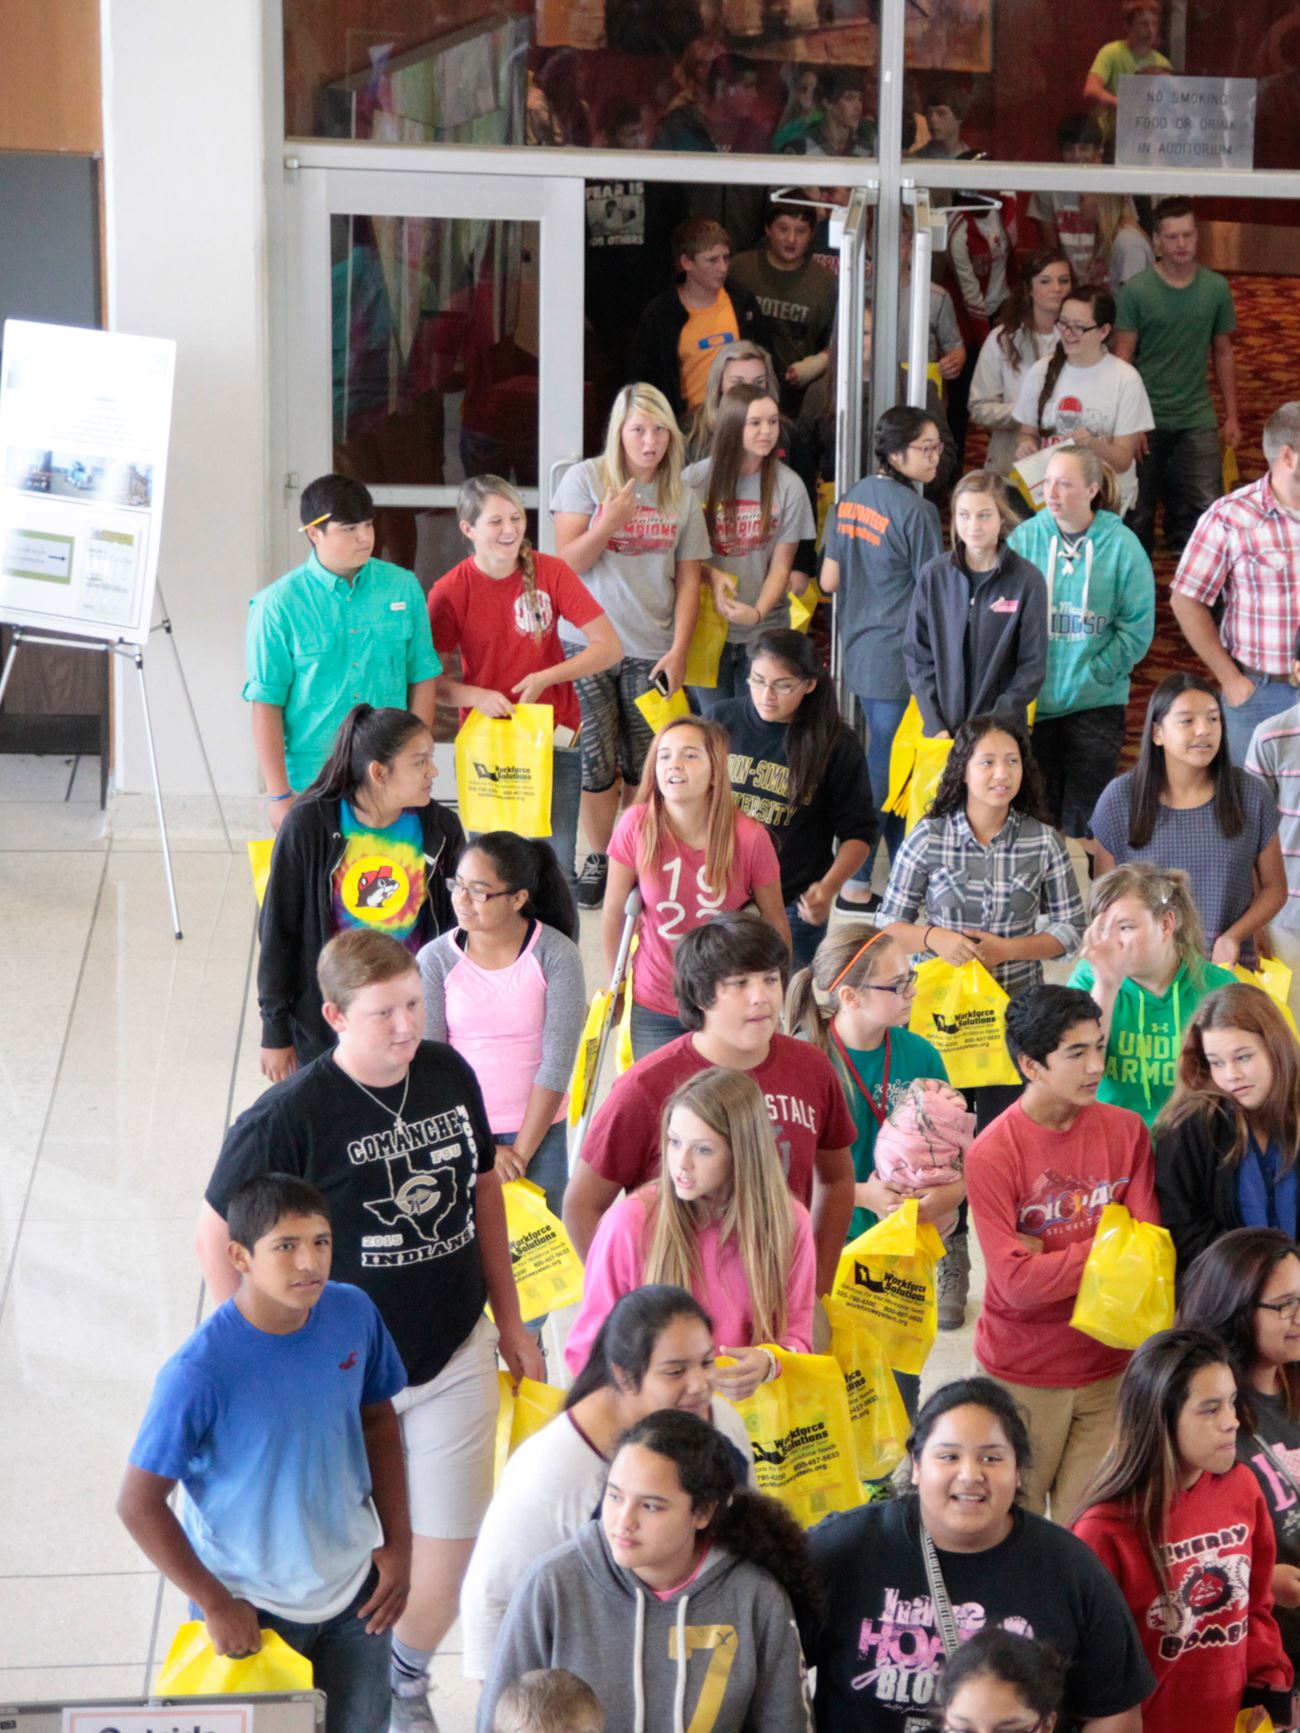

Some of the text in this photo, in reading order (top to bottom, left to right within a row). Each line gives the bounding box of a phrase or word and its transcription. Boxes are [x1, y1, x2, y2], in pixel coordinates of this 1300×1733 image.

[1146, 91, 1228, 106] NO SMOKING
[1135, 115, 1238, 131] FOOD OR DRINK
[1137, 142, 1233, 156] IN AUDITORIUM
[1104, 1055, 1177, 1087] ARMO
[346, 1108, 464, 1166] COMANCHE
[361, 1233, 404, 1249] 2015
[361, 1224, 476, 1268] INDIANS
[514, 1231, 558, 1255] Solutions
[667, 1624, 740, 1733] 7
